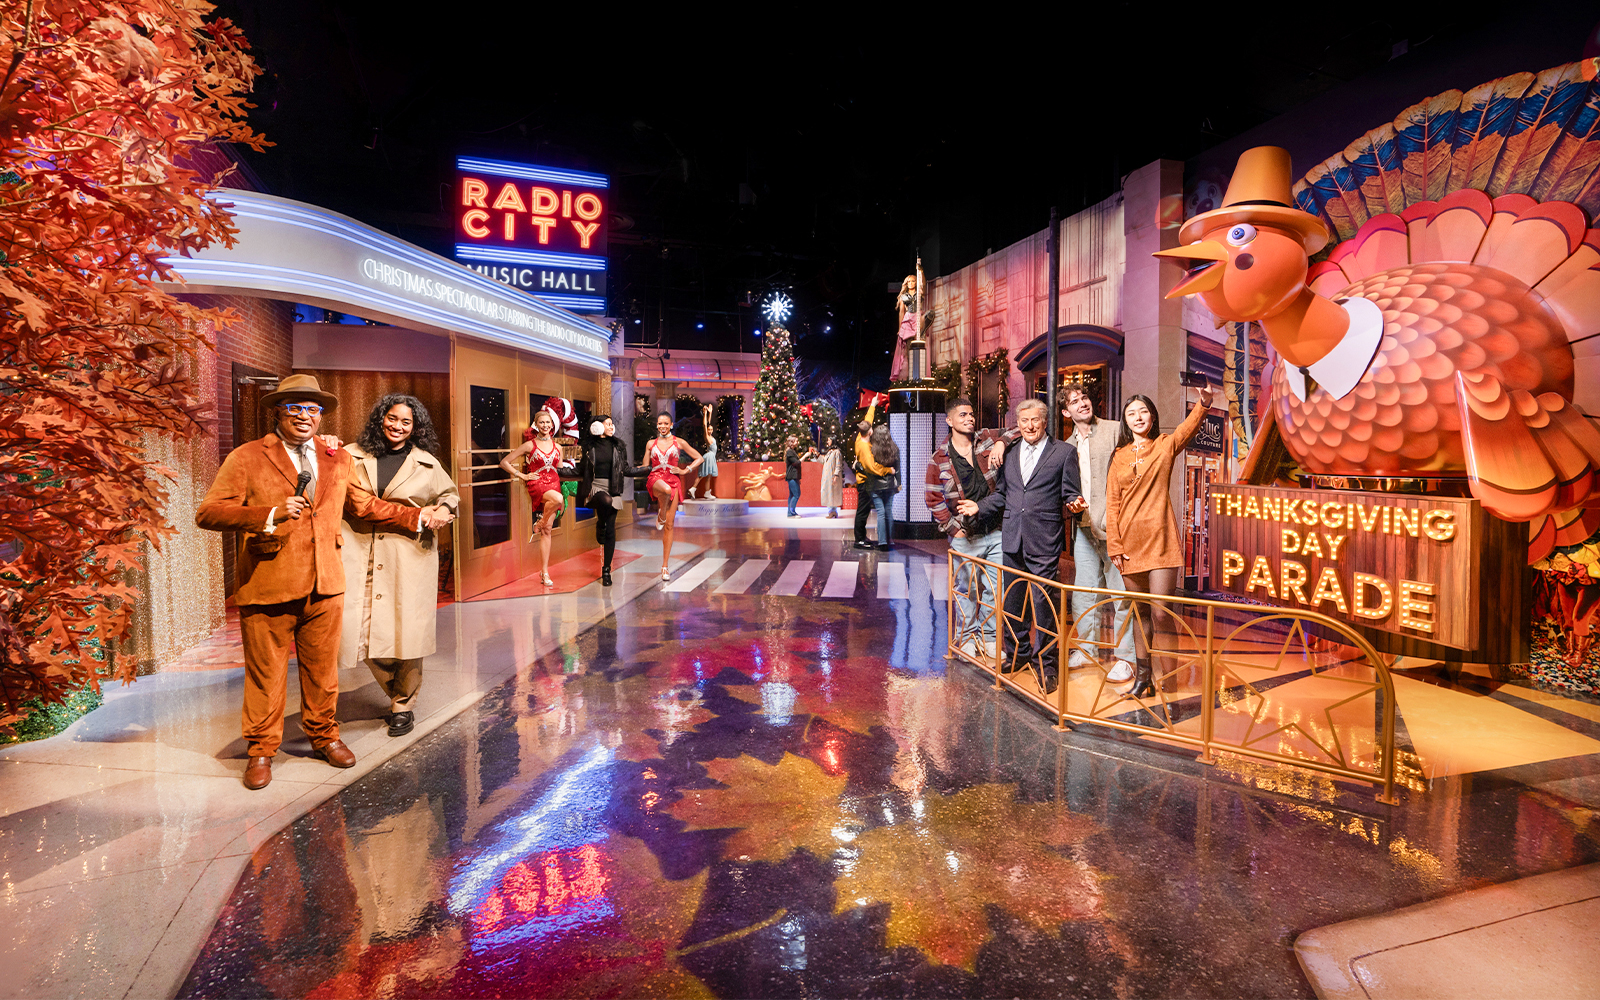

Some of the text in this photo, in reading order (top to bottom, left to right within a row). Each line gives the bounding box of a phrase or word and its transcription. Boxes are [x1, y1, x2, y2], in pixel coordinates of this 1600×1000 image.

[462, 177, 602, 221] RADIO
[462, 209, 601, 249] CITY
[363, 258, 433, 297] CHRISTMAS
[434, 282, 499, 320] SPECTACULAR
[533, 317, 546, 334] THE
[466, 264, 596, 291] USIC HALL
[1211, 493, 1459, 541] THANKSGIVING
[1281, 529, 1347, 560] DAY
[1222, 549, 1436, 633] PARADE
